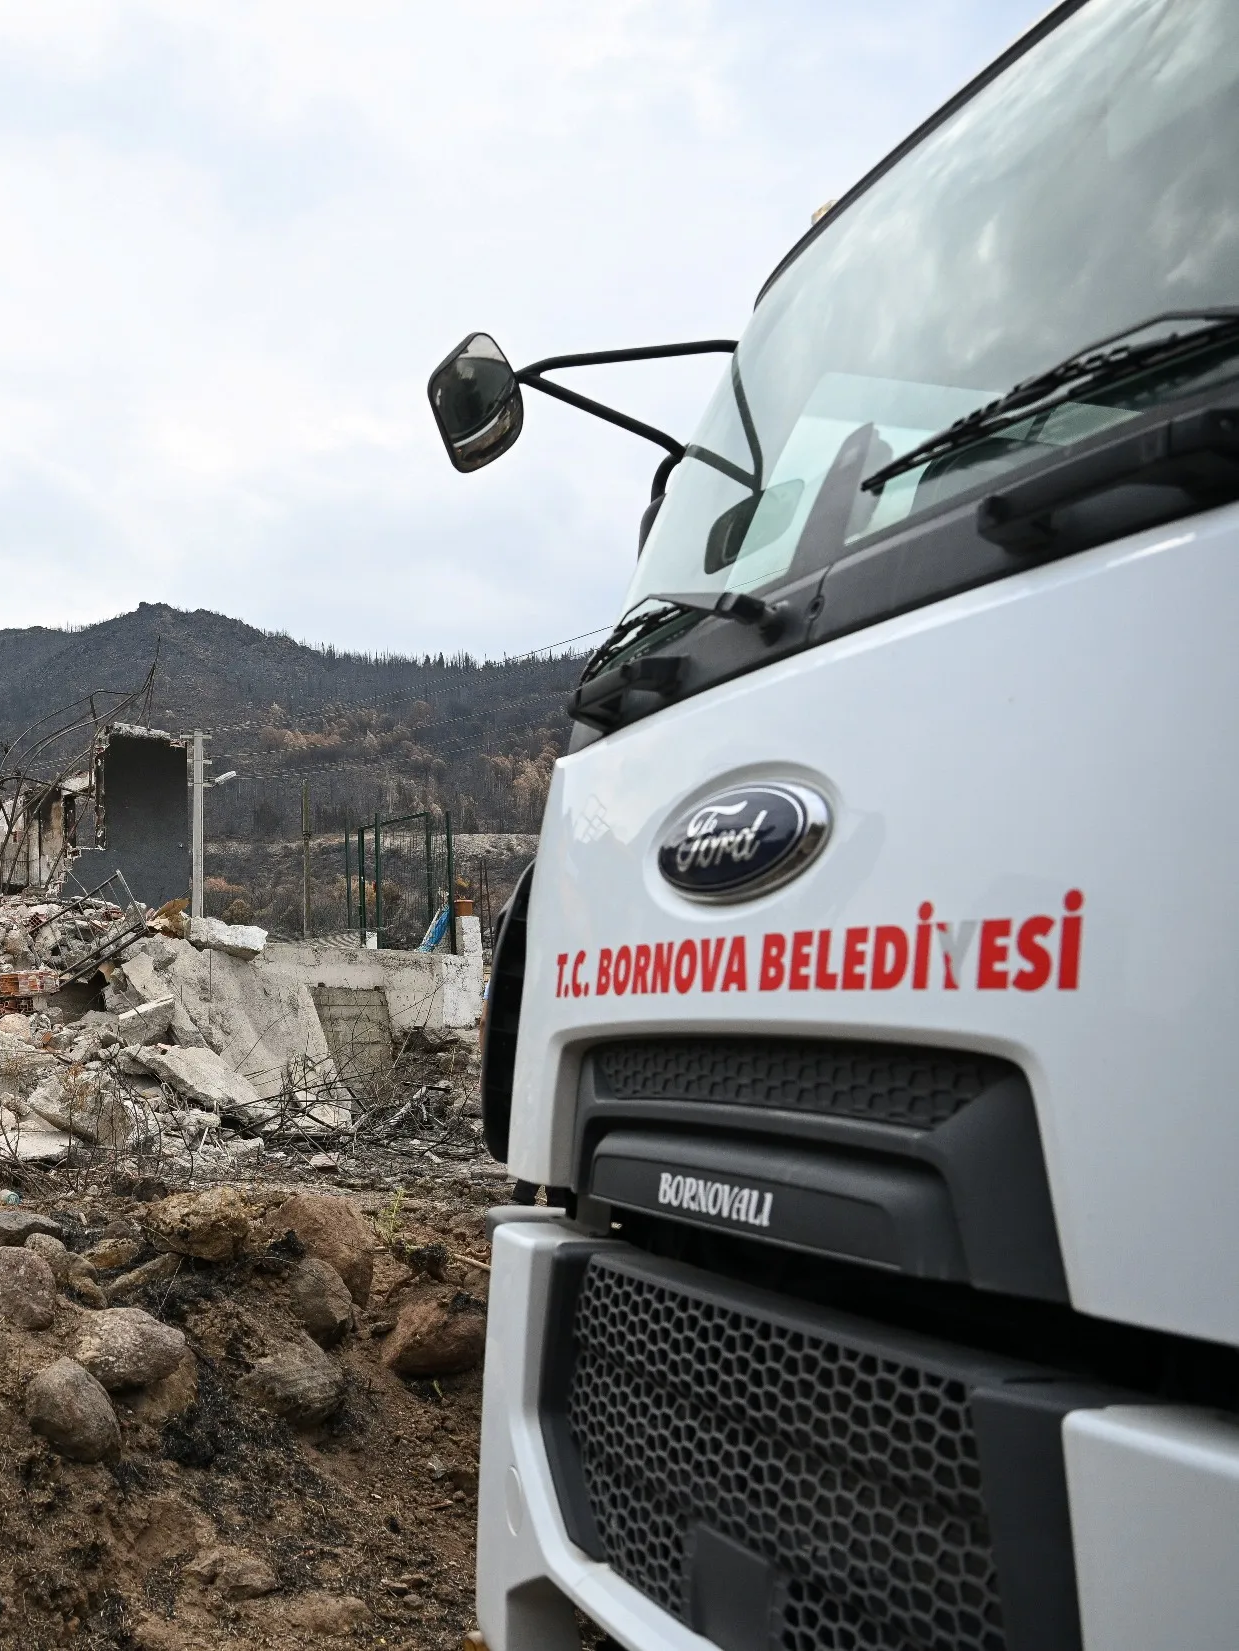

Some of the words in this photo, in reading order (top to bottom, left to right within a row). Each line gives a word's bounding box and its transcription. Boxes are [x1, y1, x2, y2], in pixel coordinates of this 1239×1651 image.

[676, 800, 768, 872] Ford
[556, 949, 589, 998] T.C.
[596, 935, 747, 996] BORNOVA
[758, 887, 1084, 993] BELEDİYESİ
[658, 1172, 774, 1227] BORNOVALI
